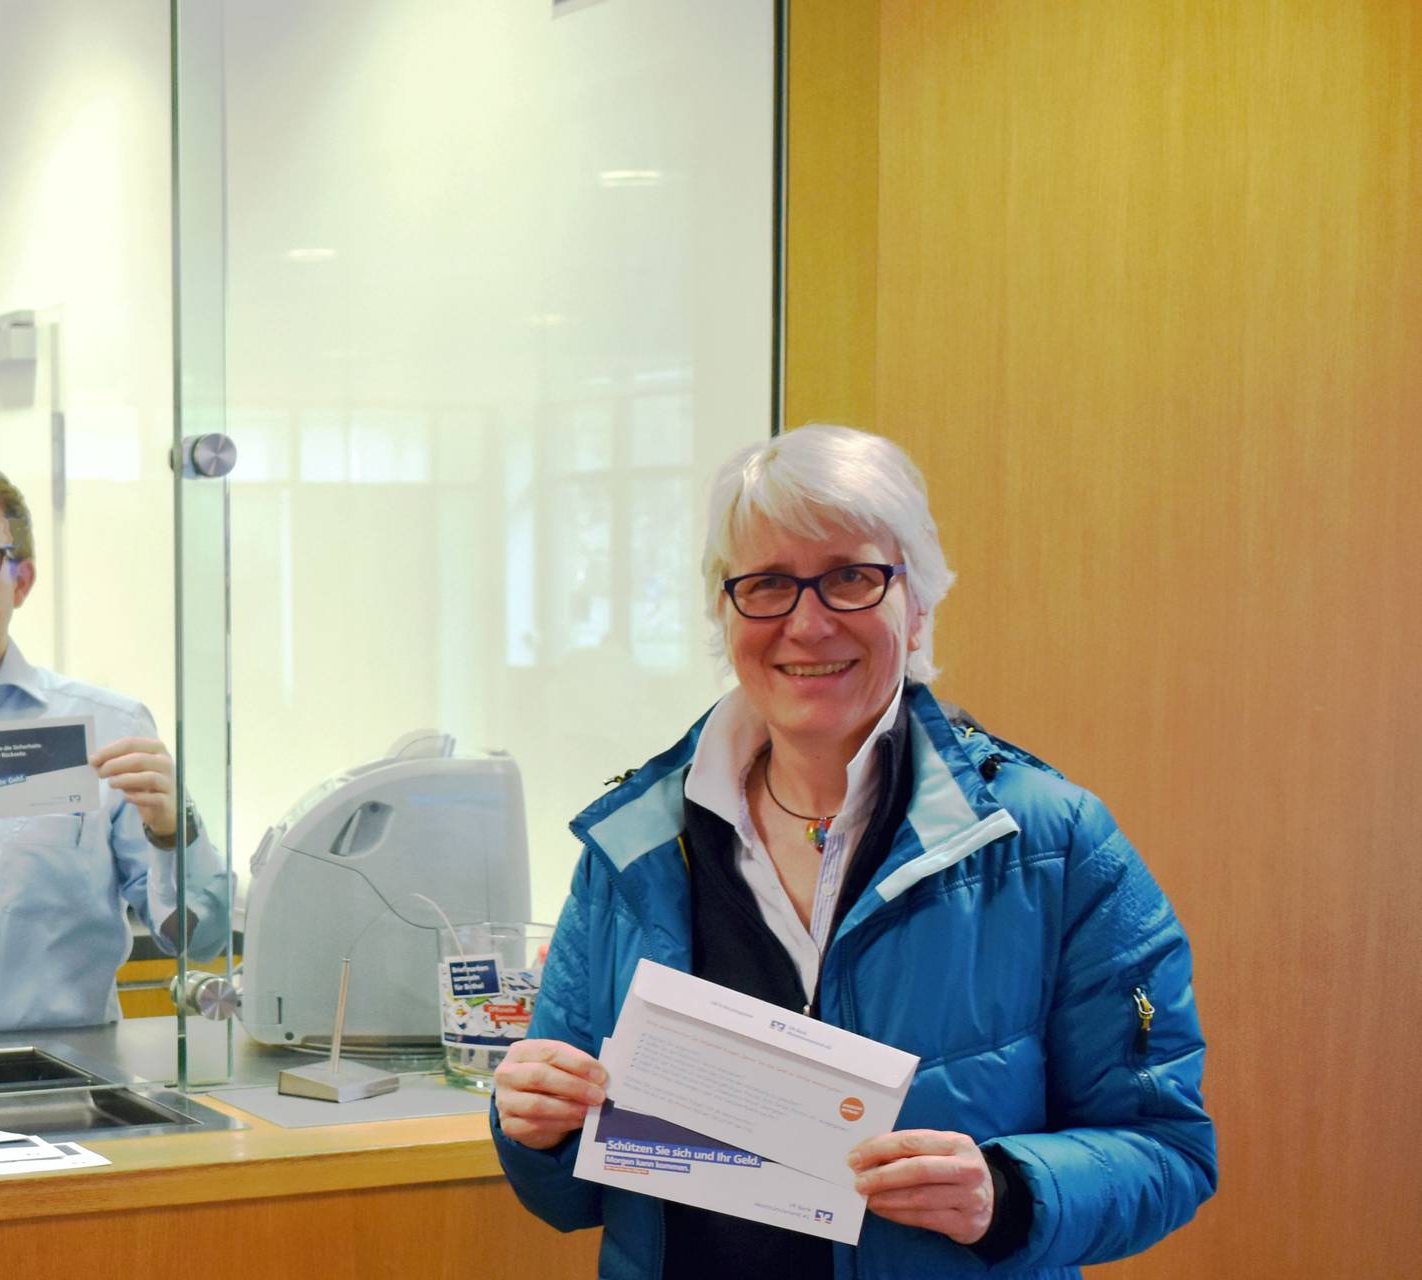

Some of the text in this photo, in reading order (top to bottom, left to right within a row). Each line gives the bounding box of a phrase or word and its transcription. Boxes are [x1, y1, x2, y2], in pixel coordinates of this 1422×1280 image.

[607, 1140, 761, 1166] Schützen Sie sich und Ihr Geld.
